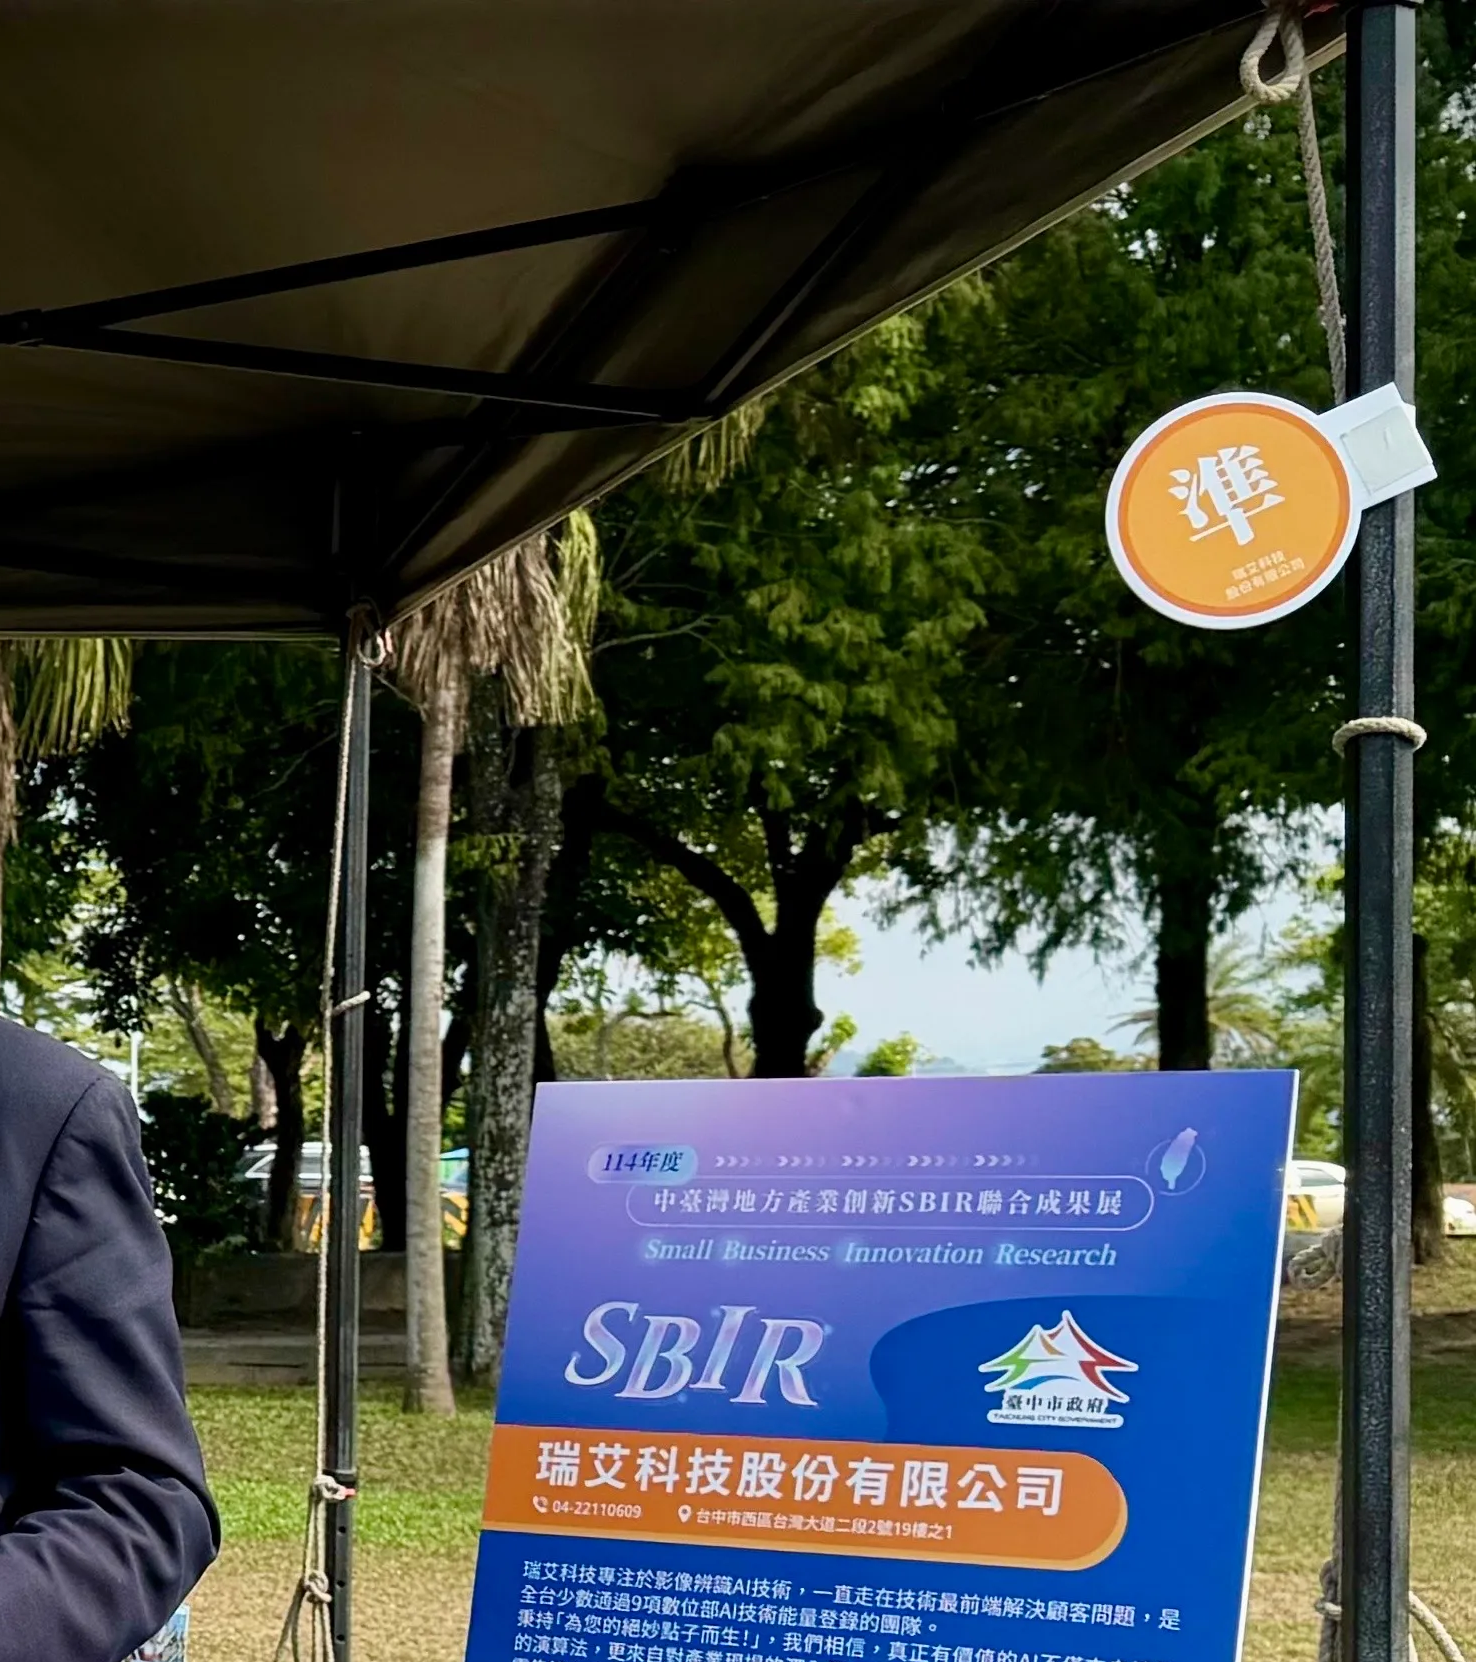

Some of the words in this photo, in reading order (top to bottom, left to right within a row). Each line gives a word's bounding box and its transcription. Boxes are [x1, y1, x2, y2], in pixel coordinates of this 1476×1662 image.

[1168, 444, 1286, 546] 準
[601, 1149, 686, 1175] 114年度
[652, 1188, 1125, 1218] 中臺灣地方產業創新SBIR聯合成果展
[643, 1238, 714, 1262] Small
[721, 1239, 830, 1265] Business
[843, 1240, 985, 1267] Innovation
[995, 1243, 1118, 1268] Research
[562, 1299, 826, 1407] SBIR
[1006, 1394, 1104, 1413] 臺中市政府
[535, 1439, 1065, 1517] 瑞艾科技股份有限公司
[552, 1499, 642, 1519] 04-22110609
[696, 1507, 954, 1541] 台中市西區台灣大道二段2號19樓之1
